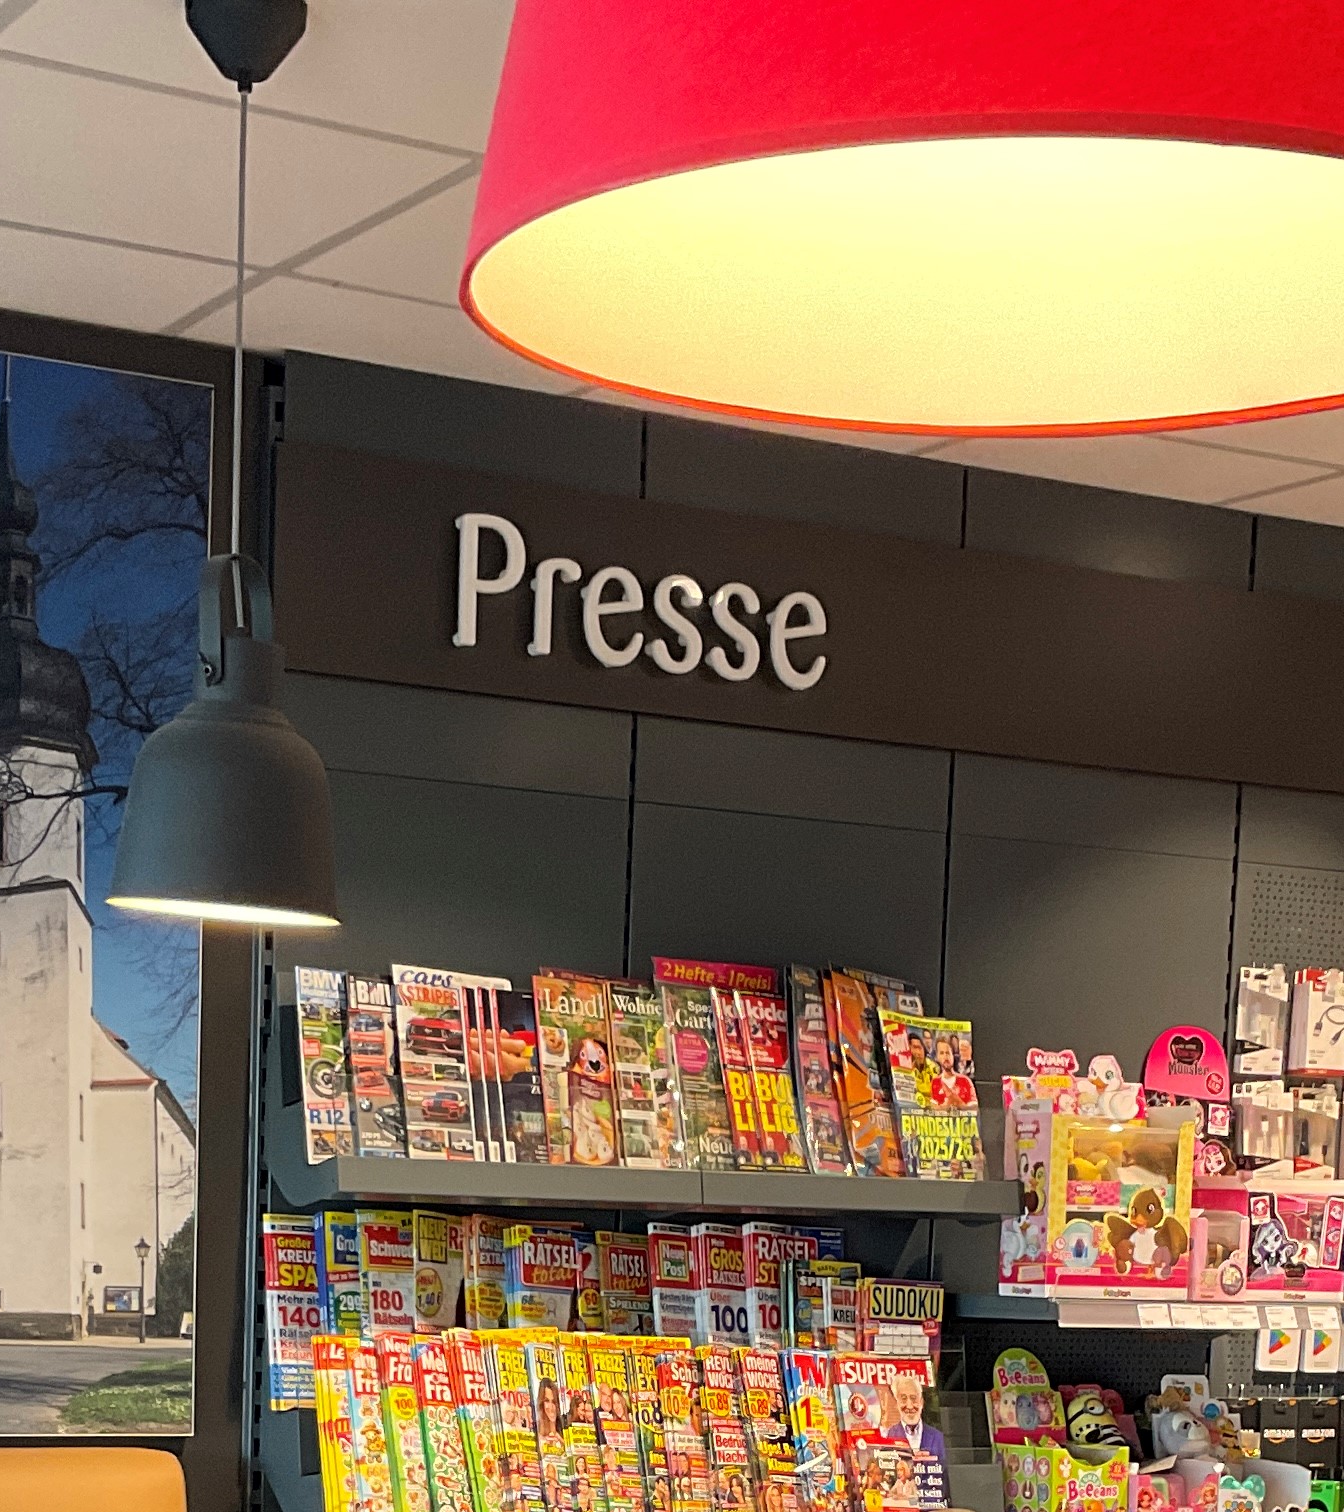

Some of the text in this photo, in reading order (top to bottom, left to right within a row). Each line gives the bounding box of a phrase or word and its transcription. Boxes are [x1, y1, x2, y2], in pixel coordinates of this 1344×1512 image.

[453, 513, 827, 691] Presse
[399, 970, 454, 989] cars
[662, 962, 671, 977] 2
[674, 966, 714, 983] Hefte
[357, 980, 391, 1006] BM
[901, 1115, 979, 1138] BUNDESLIGA
[918, 1137, 974, 1162] 2025/26
[419, 1216, 446, 1239] NEUE
[277, 1237, 312, 1250] Großer
[523, 1238, 579, 1269] RÄTSEL
[757, 1233, 811, 1261] RÄTSEL
[610, 1249, 647, 1277] RÄTSEL
[663, 1260, 686, 1277] Post
[531, 1267, 574, 1284] total
[277, 1294, 304, 1305] Mehr
[371, 1289, 404, 1312] 180
[872, 1285, 940, 1319] SUDOKU
[278, 1306, 320, 1328] 140
[711, 1304, 749, 1333] 100
[745, 1353, 777, 1372] meine
[746, 1371, 781, 1391] WOCHE
[797, 1382, 829, 1400] direkt
[800, 1397, 812, 1428] 1
[1263, 1428, 1295, 1438] amazon
[1301, 1428, 1335, 1438] amazon
